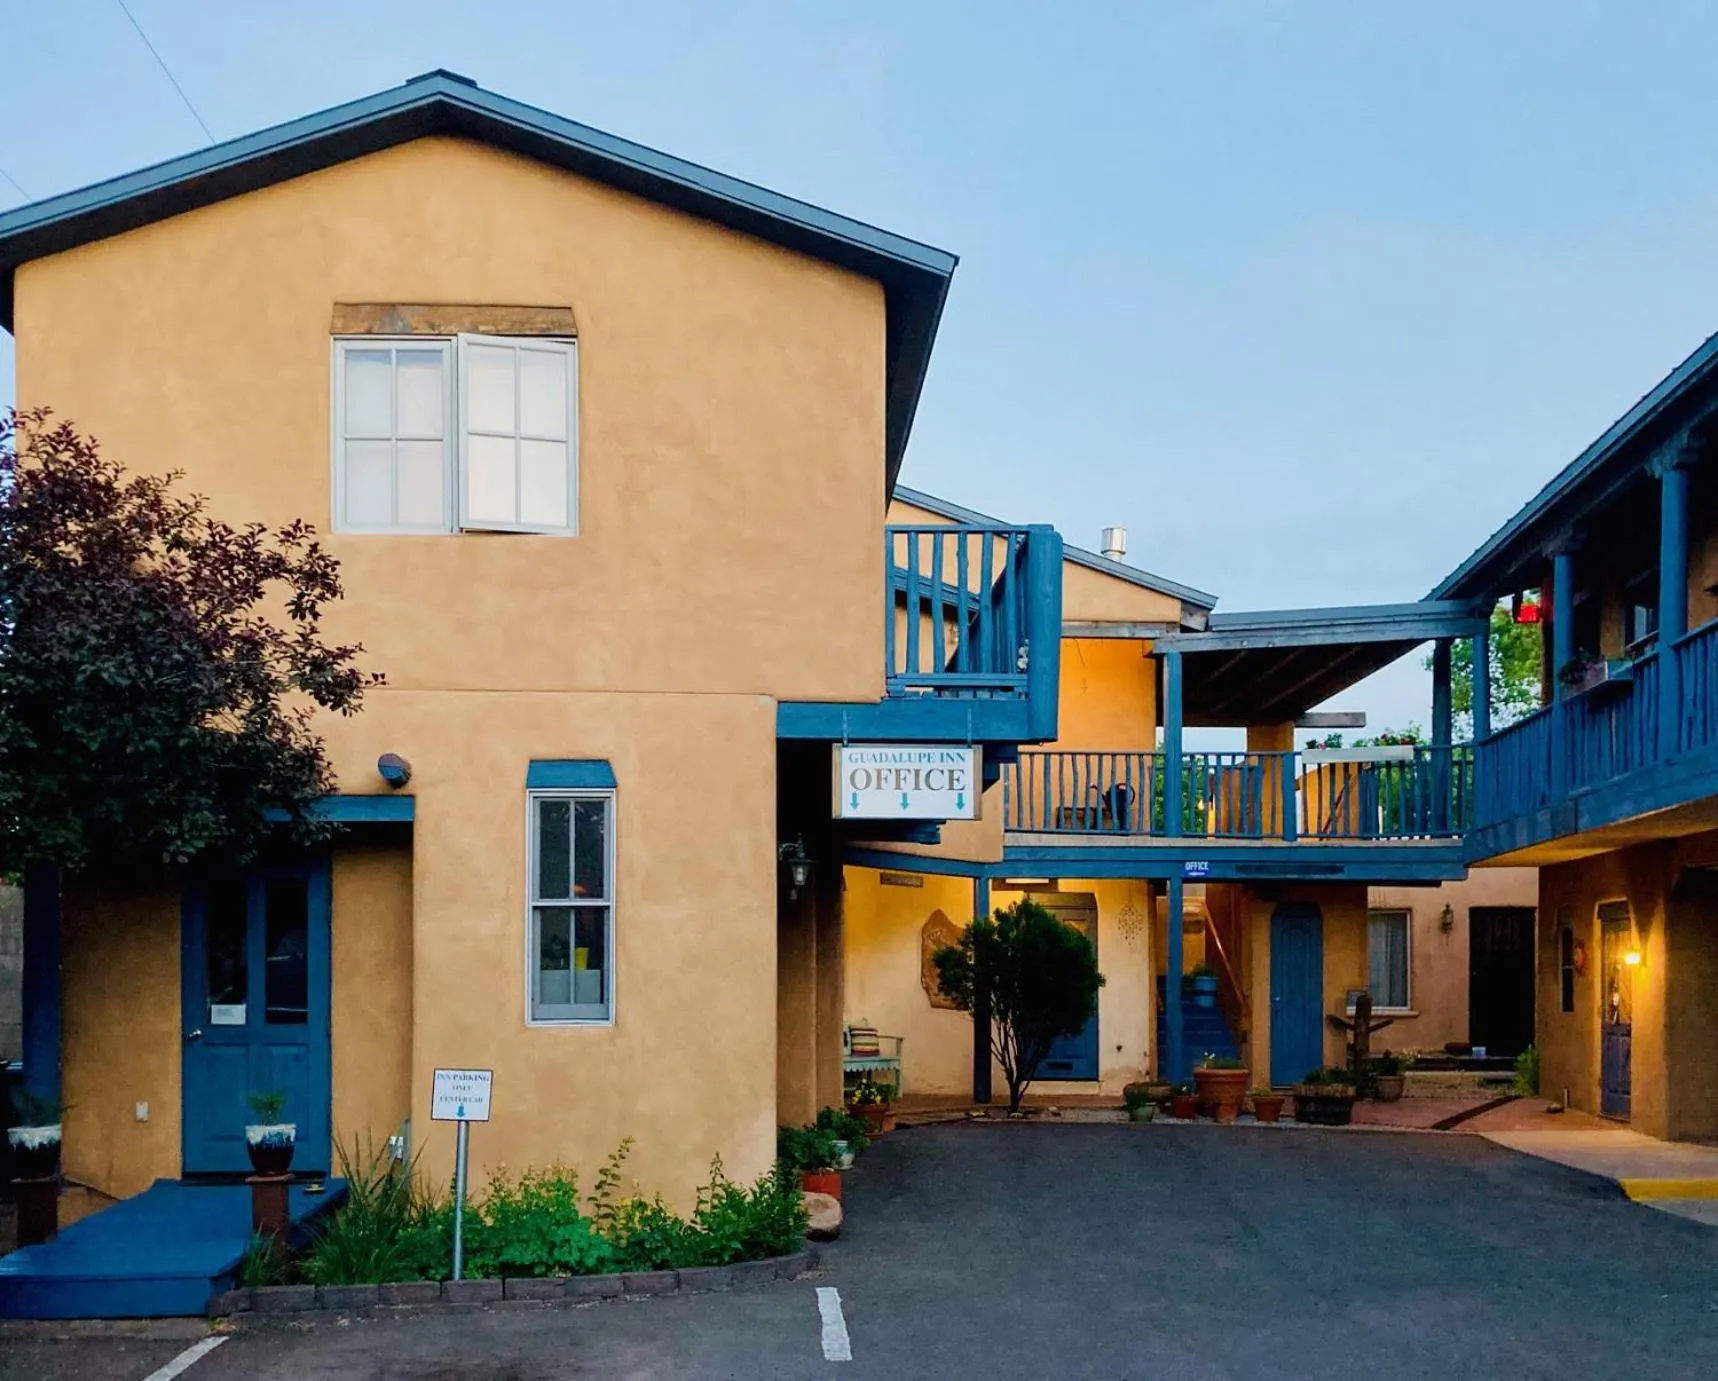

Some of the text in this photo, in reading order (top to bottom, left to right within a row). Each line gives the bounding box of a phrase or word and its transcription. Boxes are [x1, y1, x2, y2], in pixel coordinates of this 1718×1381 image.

[848, 751, 966, 763] GUADALUPE INN
[849, 767, 967, 791] OFFICE
[1185, 861, 1209, 871] OFFICE
[452, 1073, 489, 1082] PARKING
